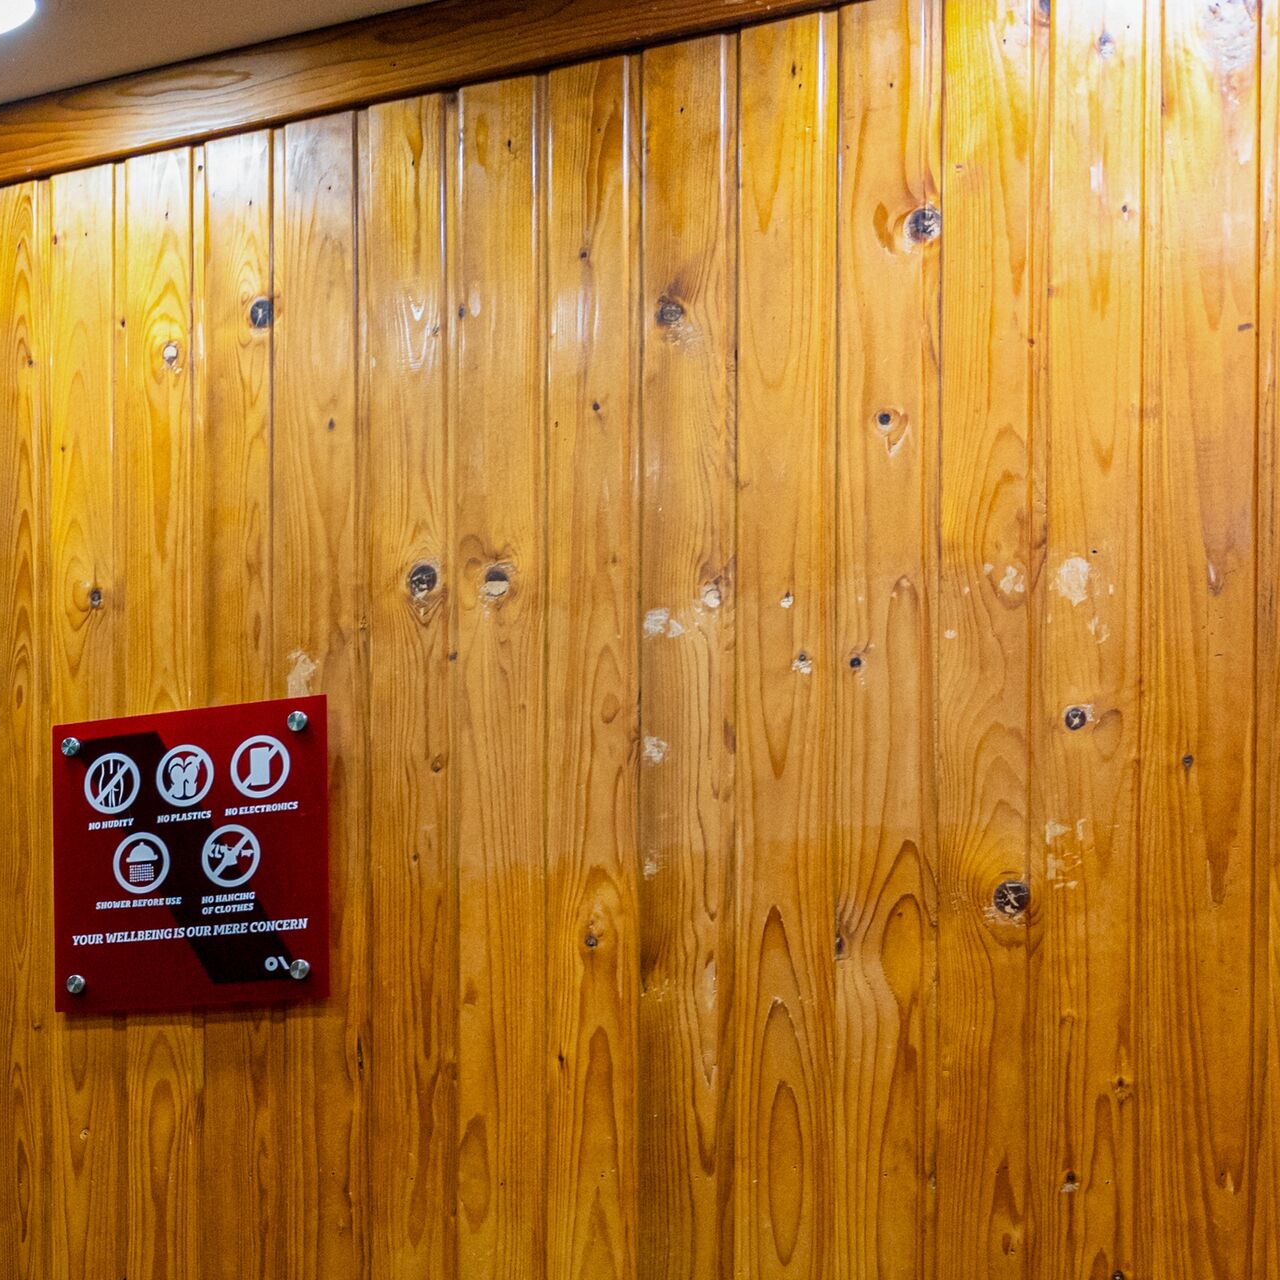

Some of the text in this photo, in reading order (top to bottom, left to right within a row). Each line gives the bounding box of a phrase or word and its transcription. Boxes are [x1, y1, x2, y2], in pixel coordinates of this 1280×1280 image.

[225, 801, 298, 816] NO ELECTRONICS
[157, 810, 211, 823] NO PLASTICS
[89, 818, 134, 830] NO NUDITY
[96, 897, 182, 909] SHOWER BEFORE USE
[202, 896, 213, 904] NO
[215, 903, 254, 913] CLOTHES
[73, 918, 308, 945] YOUR WELLBEING IS OUR MERE CONCERN
